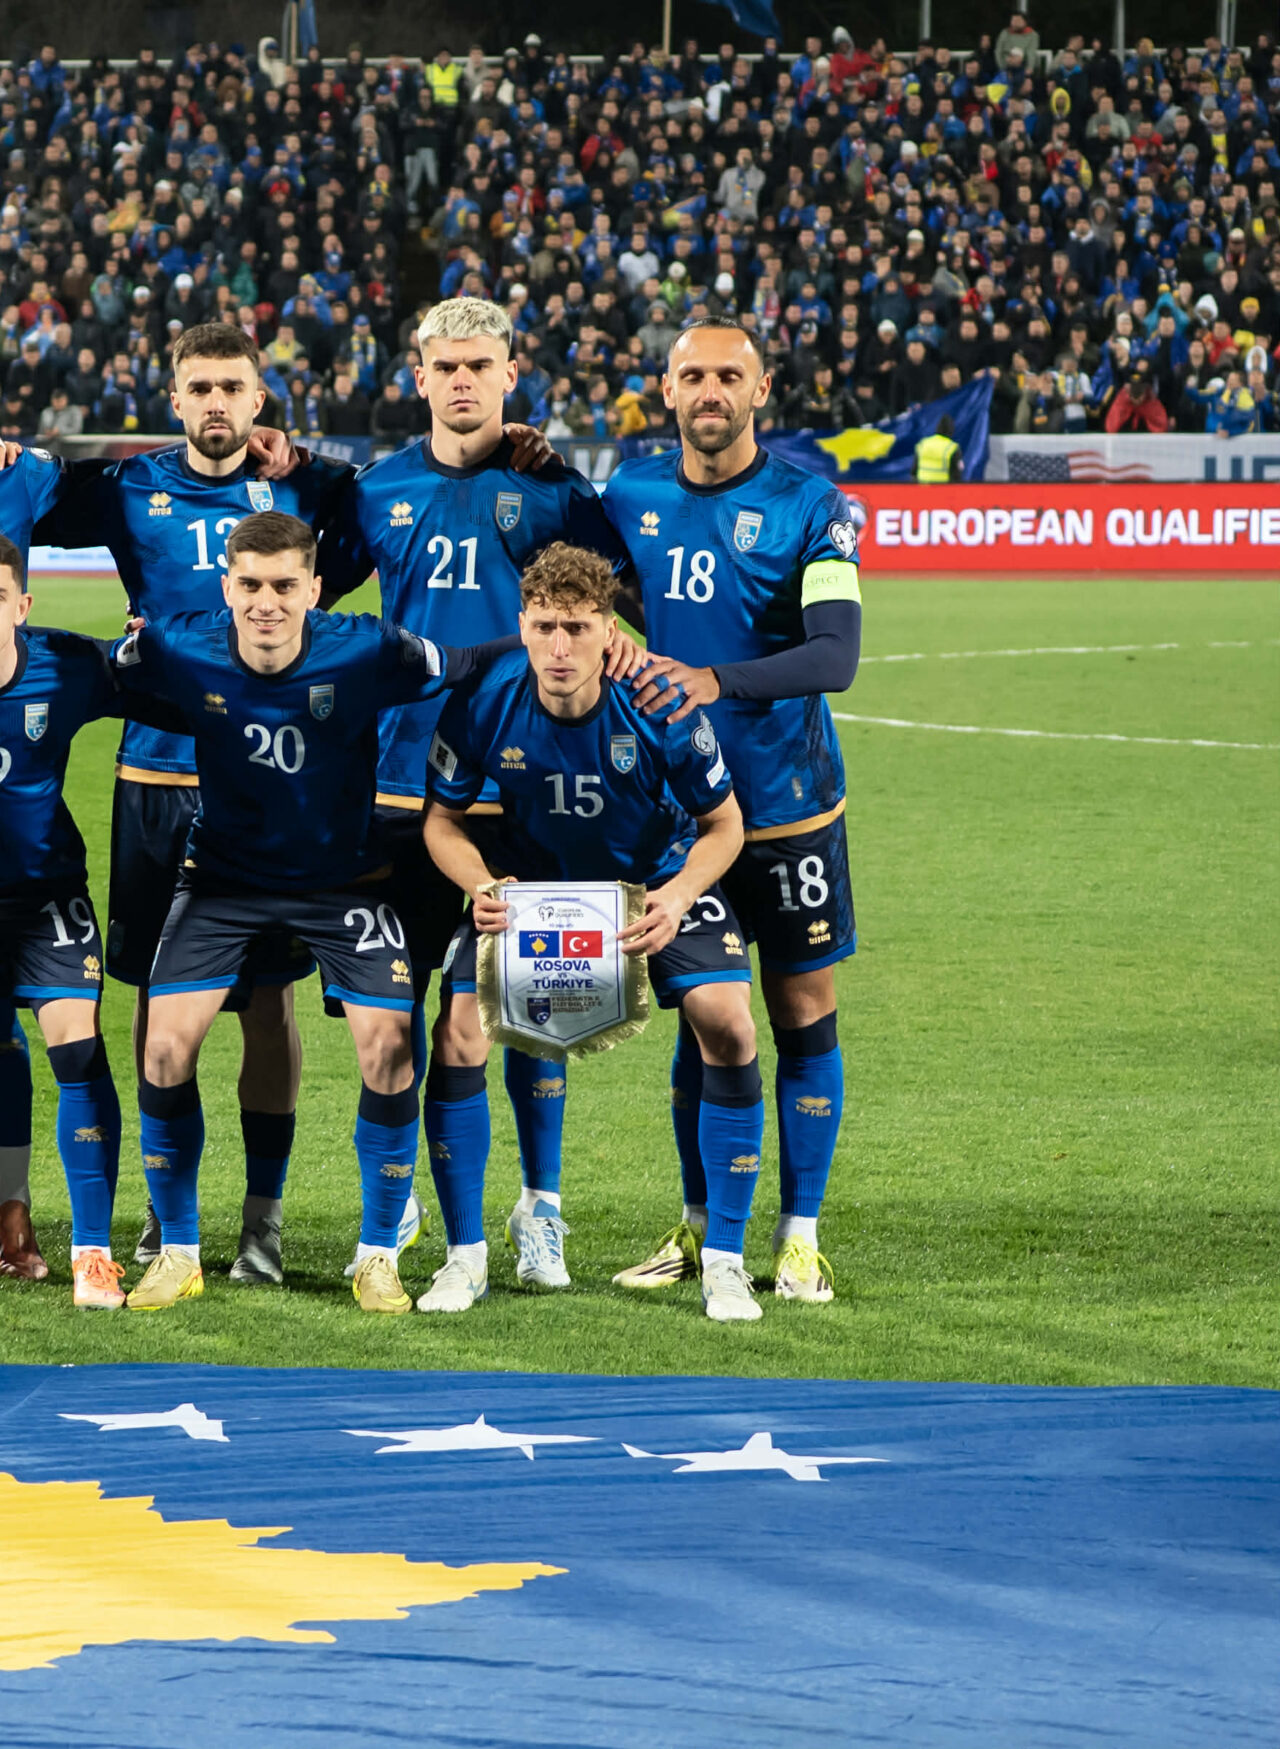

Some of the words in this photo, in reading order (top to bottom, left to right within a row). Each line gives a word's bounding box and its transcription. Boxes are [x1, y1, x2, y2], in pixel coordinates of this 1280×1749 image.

[876, 509, 1093, 546] EUROPEAN
[1106, 509, 1280, 546] QUALIFIE
[427, 535, 481, 590] 21
[664, 546, 716, 603] 18
[244, 723, 305, 774] 20
[544, 773, 604, 818] 15
[769, 855, 829, 912] 18
[40, 897, 95, 947] 19
[343, 903, 405, 953] 20
[533, 977, 594, 989] TÜRKIYE
[534, 960, 591, 971] KOSOVA
